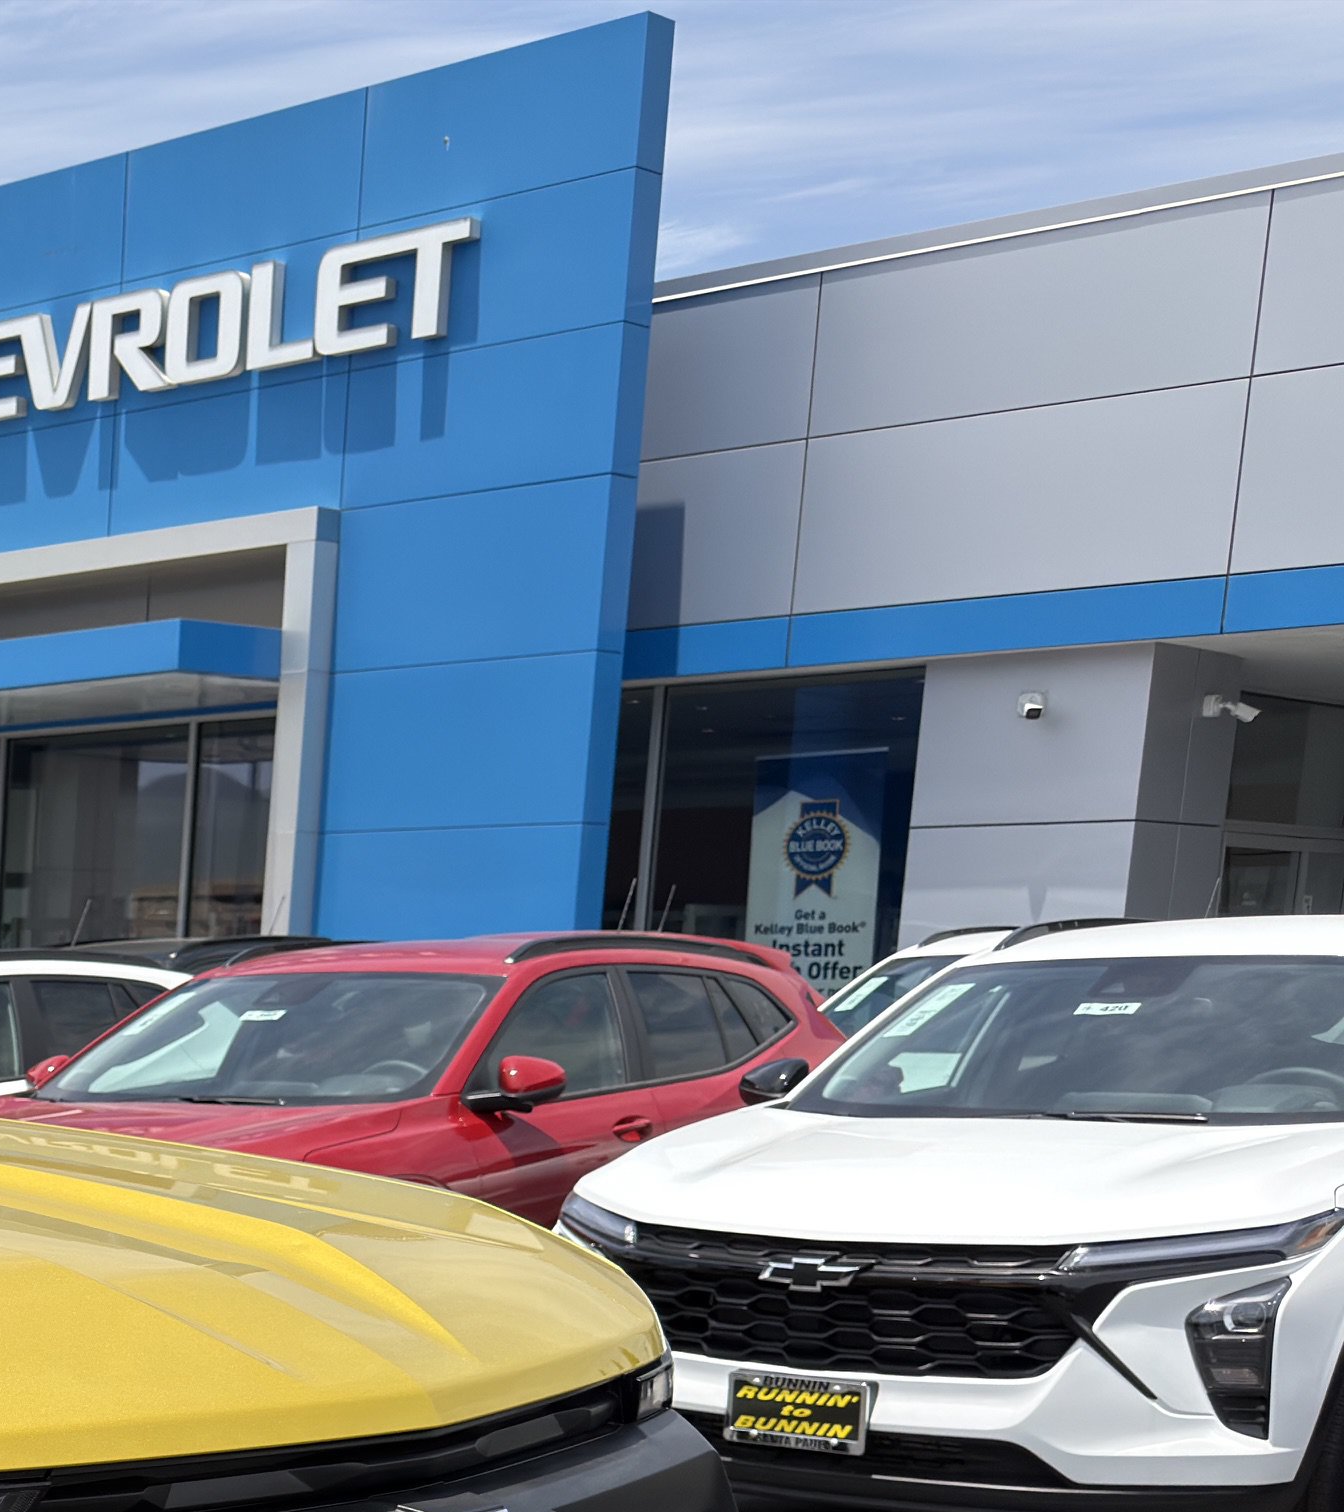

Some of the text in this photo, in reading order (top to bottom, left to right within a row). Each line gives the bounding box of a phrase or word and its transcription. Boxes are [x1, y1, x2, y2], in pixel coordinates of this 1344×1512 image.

[796, 818, 841, 837] KELLEY
[789, 839, 844, 853] BLUE BOOK
[795, 910, 826, 920] Get a
[755, 924, 793, 936] Kelley
[797, 923, 825, 934] Blue
[809, 962, 863, 979] Offer
[763, 1375, 830, 1391] BUNNIN
[736, 1385, 860, 1408] RUNNIN'
[780, 1405, 812, 1418] to
[734, 1414, 853, 1439] BUNNIN
